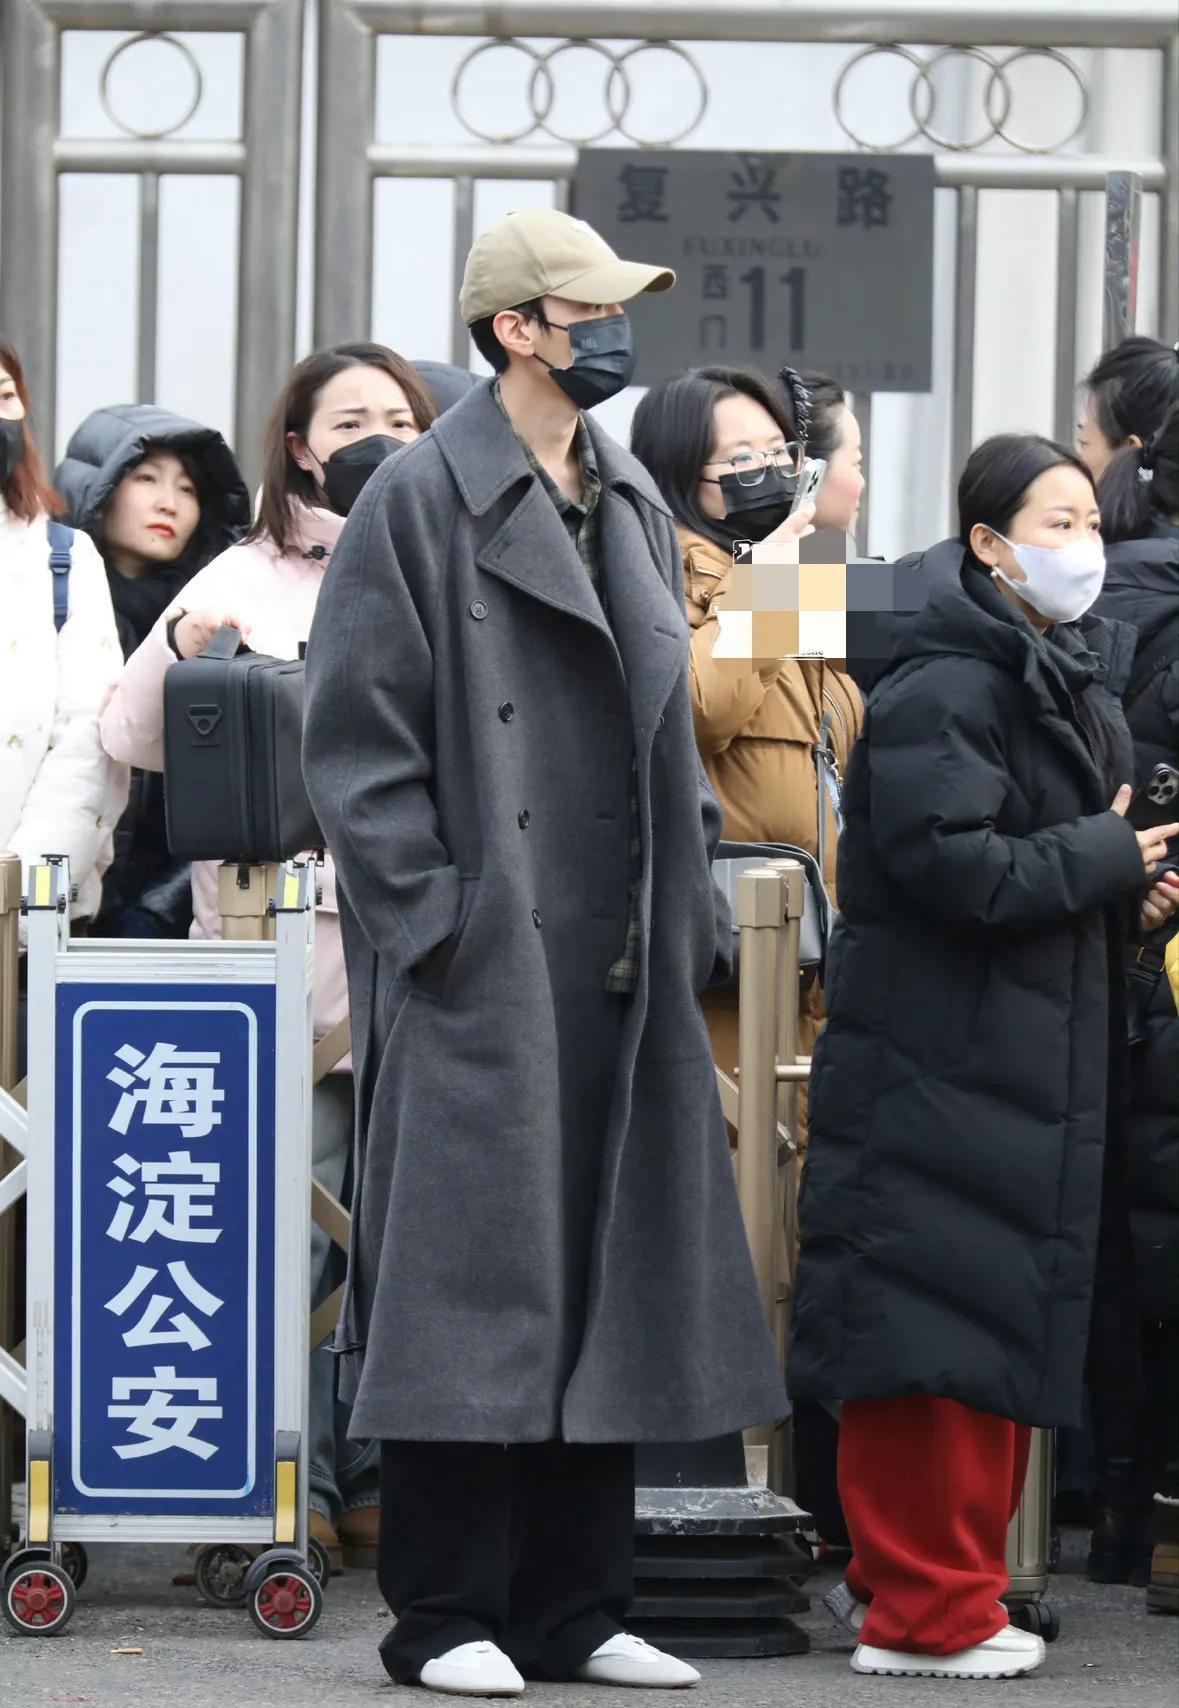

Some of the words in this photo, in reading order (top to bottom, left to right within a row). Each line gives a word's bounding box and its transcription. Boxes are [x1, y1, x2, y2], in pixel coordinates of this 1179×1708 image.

[617, 153, 891, 229] 复兴路
[740, 265, 806, 352] 11
[104, 1042, 225, 1461] 海淀公安
